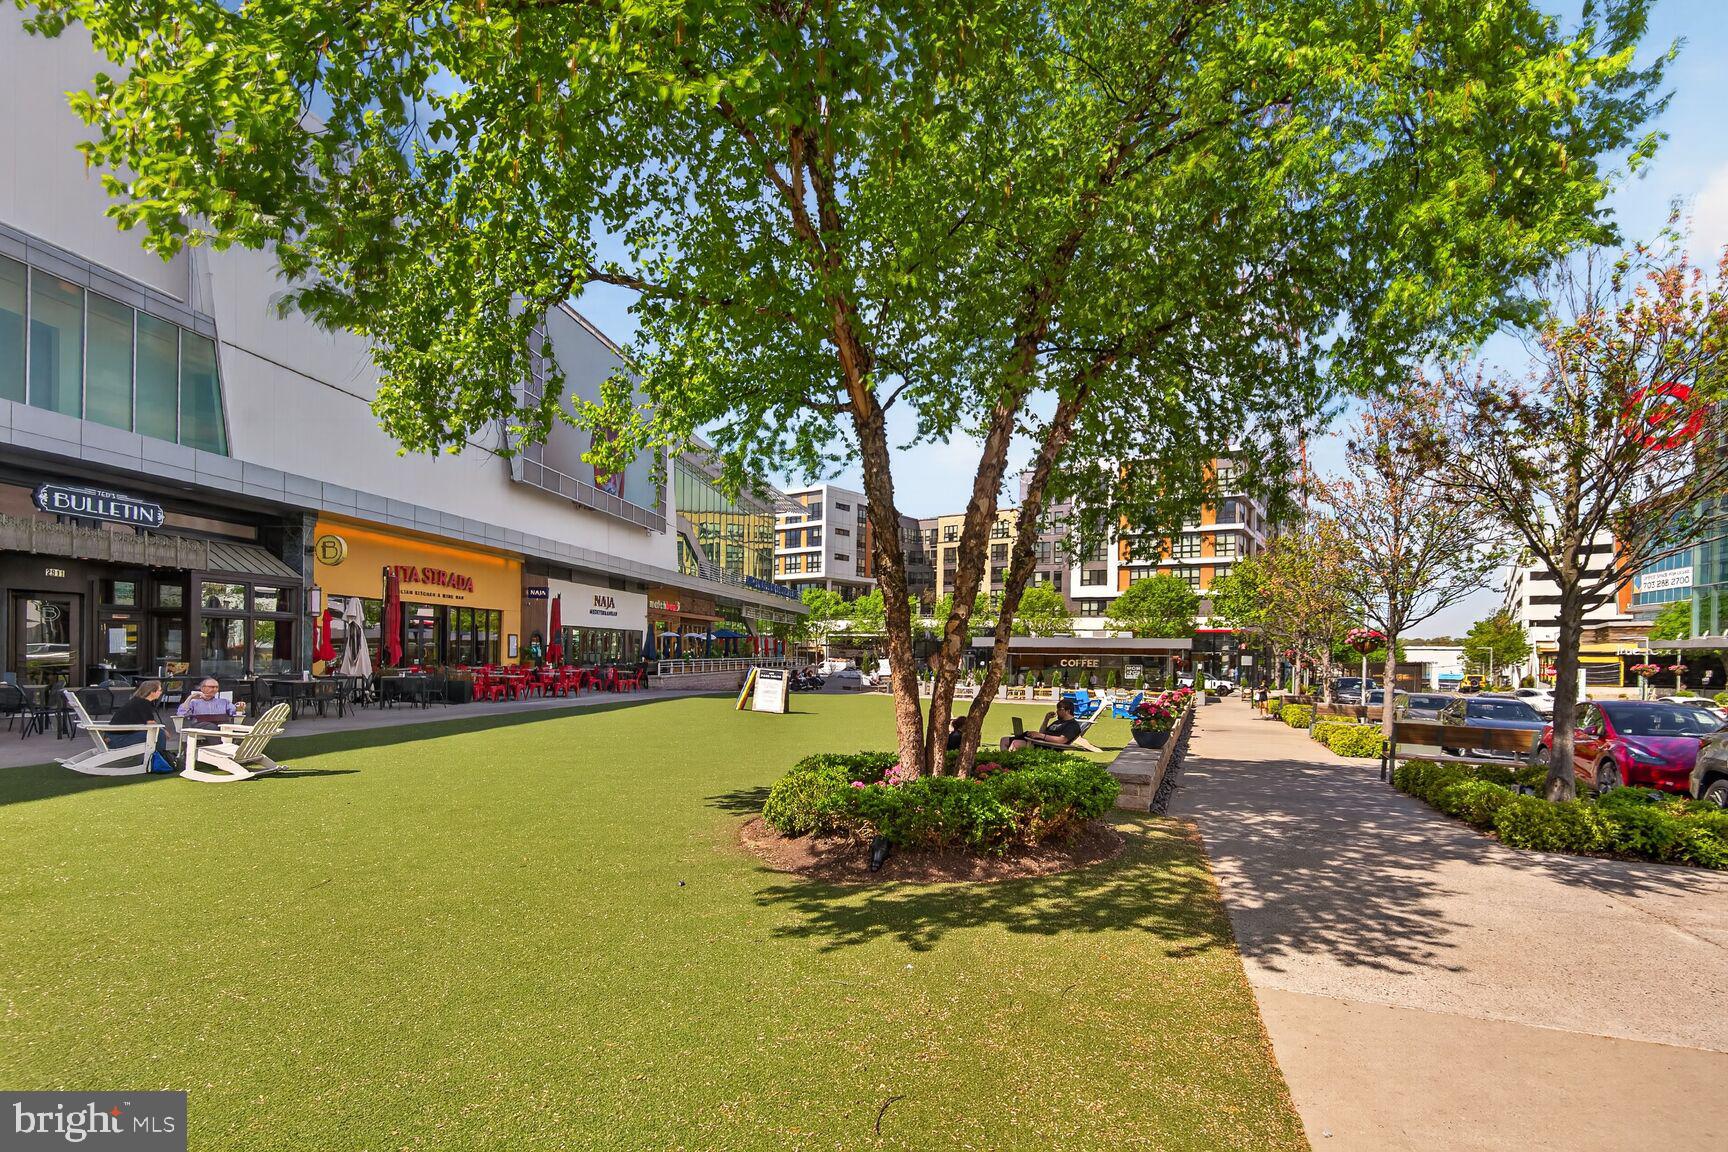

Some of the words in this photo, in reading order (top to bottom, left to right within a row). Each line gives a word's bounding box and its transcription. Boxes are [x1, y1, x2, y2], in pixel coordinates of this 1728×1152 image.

[54, 492, 154, 522] BULLETIN
[422, 567, 474, 593] STRADA
[1643, 581, 1656, 589] 703
[1670, 576, 1690, 586] 2700
[594, 594, 615, 610] NAJA
[1060, 659, 1100, 668] COFFEE
